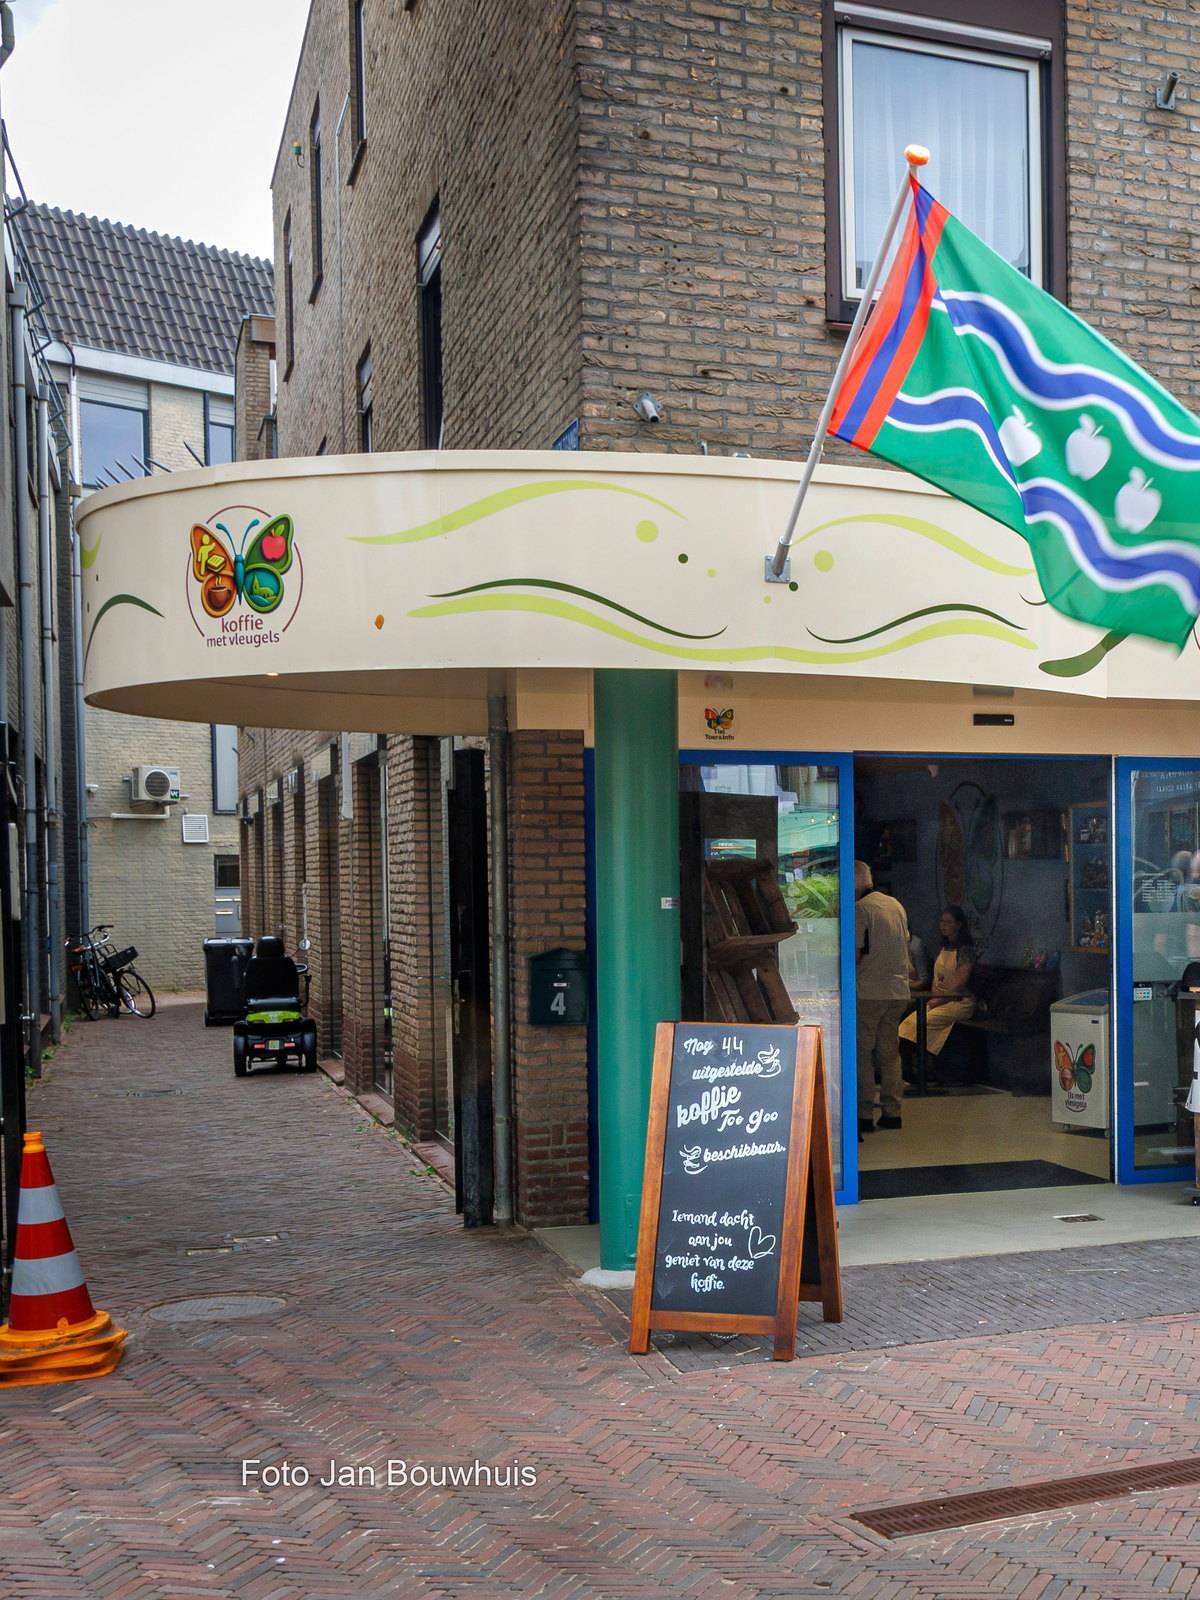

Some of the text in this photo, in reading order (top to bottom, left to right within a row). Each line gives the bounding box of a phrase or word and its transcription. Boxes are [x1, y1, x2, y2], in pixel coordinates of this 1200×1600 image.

[221, 614, 264, 633] koffie
[206, 630, 280, 648] met vleugels
[550, 991, 567, 1016] 4
[683, 1036, 744, 1056] Nog 44
[691, 1060, 764, 1083] uitgestelde
[676, 1085, 742, 1128] koffie
[703, 1140, 786, 1163] beschikbaar.
[671, 1210, 754, 1230] Iemand dacht
[688, 1233, 733, 1251] aan jou
[665, 1252, 755, 1271] geniet van deze
[690, 1272, 726, 1292] koffie.
